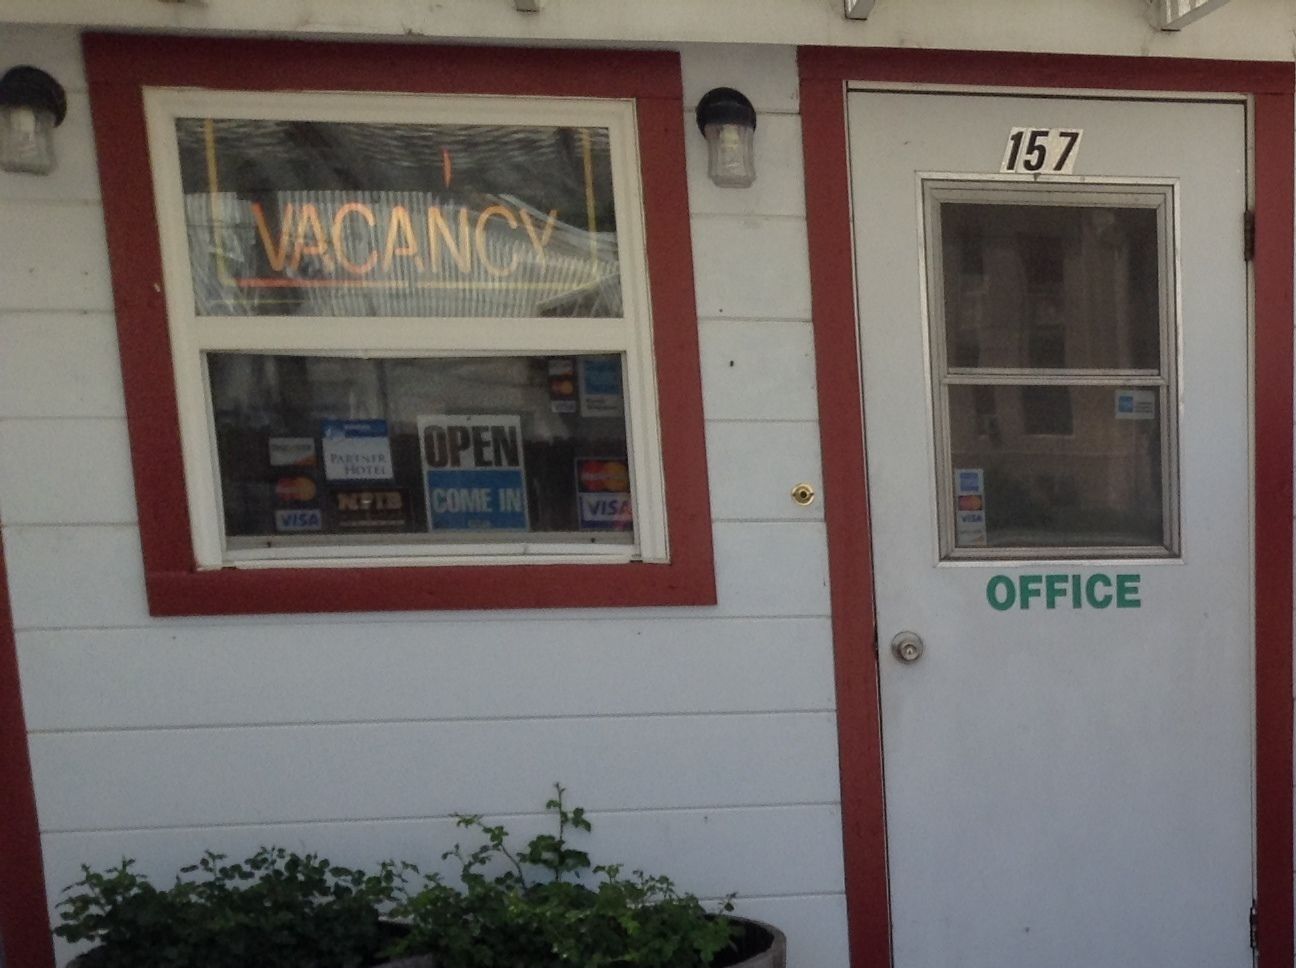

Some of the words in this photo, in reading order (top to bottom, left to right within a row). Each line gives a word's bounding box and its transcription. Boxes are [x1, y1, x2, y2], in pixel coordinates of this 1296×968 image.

[1006, 130, 1080, 172] 157
[250, 202, 559, 277] VACANCY
[330, 453, 386, 465] PARTNER
[423, 425, 520, 468] OPEN
[345, 464, 386, 476] HOTEL
[432, 488, 493, 513] COME
[499, 488, 522, 513] IN
[586, 499, 633, 516] VISA
[280, 512, 319, 527] VISA
[986, 573, 1142, 612] OFFICE
